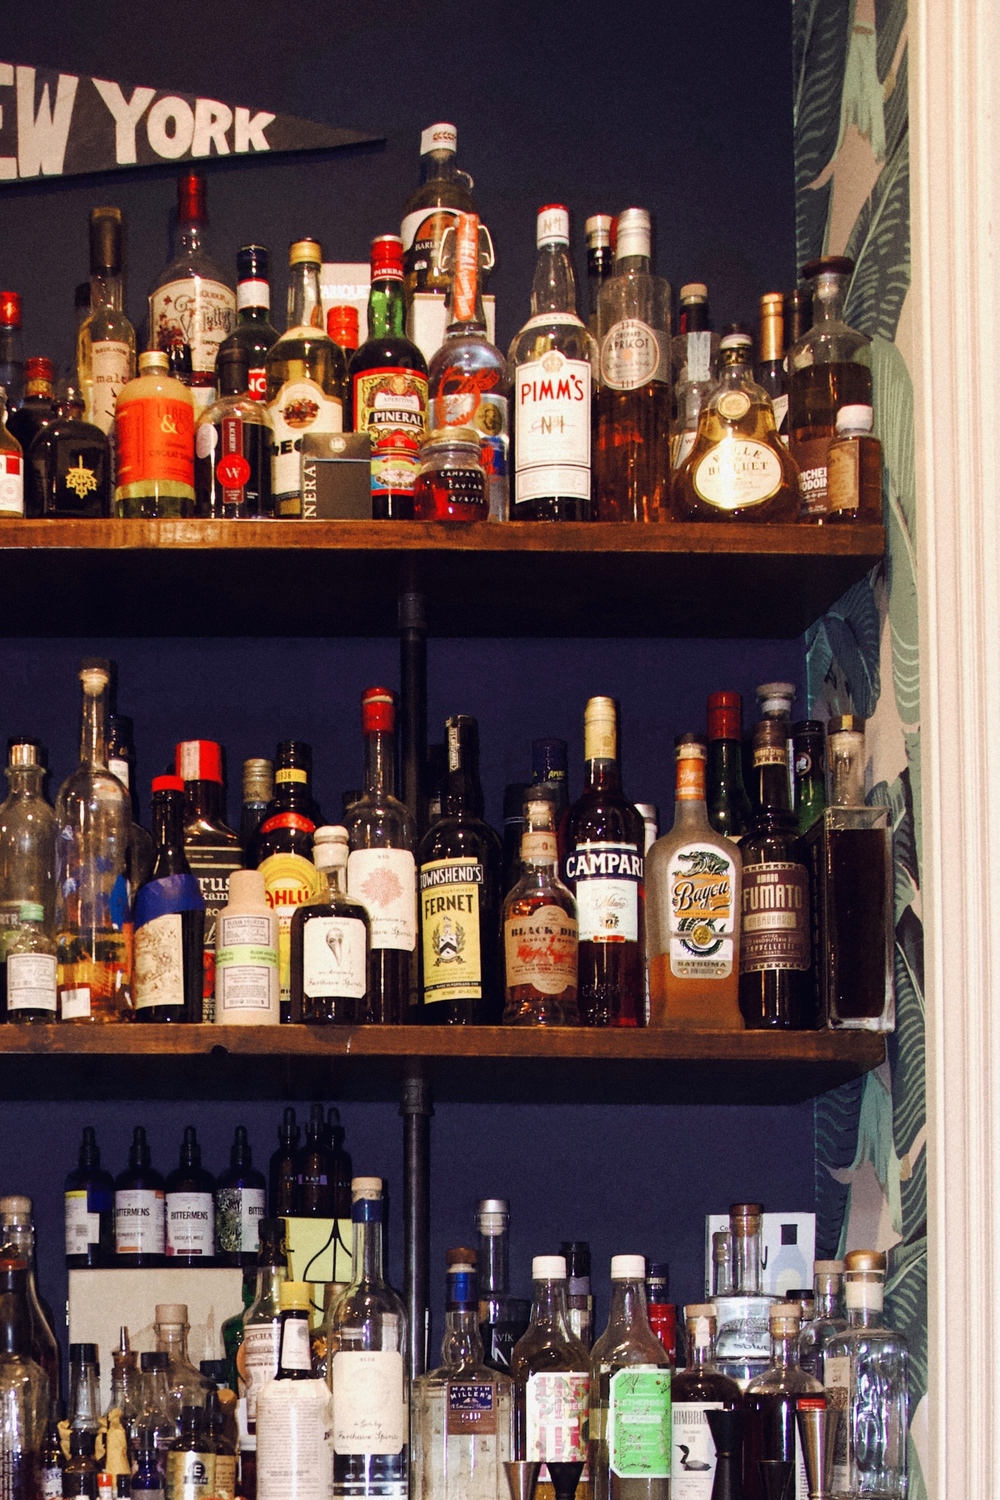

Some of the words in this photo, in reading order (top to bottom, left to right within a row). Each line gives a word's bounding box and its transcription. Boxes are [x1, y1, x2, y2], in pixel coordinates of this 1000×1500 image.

[92, 76, 276, 165] YORK
[521, 373, 585, 403] PIMM'S
[373, 411, 422, 427] PINERAL
[421, 866, 482, 889] TOWNSHEND'S
[566, 852, 644, 878] CAMPARI
[264, 886, 316, 910] AHLÚ
[425, 894, 474, 921] FERNET
[674, 880, 731, 914] Bayou
[743, 883, 802, 912] FUMATO
[511, 926, 554, 938] BLACK
[171, 1211, 209, 1220] BITTERMENS
[451, 1391, 492, 1400] MILLER'S
